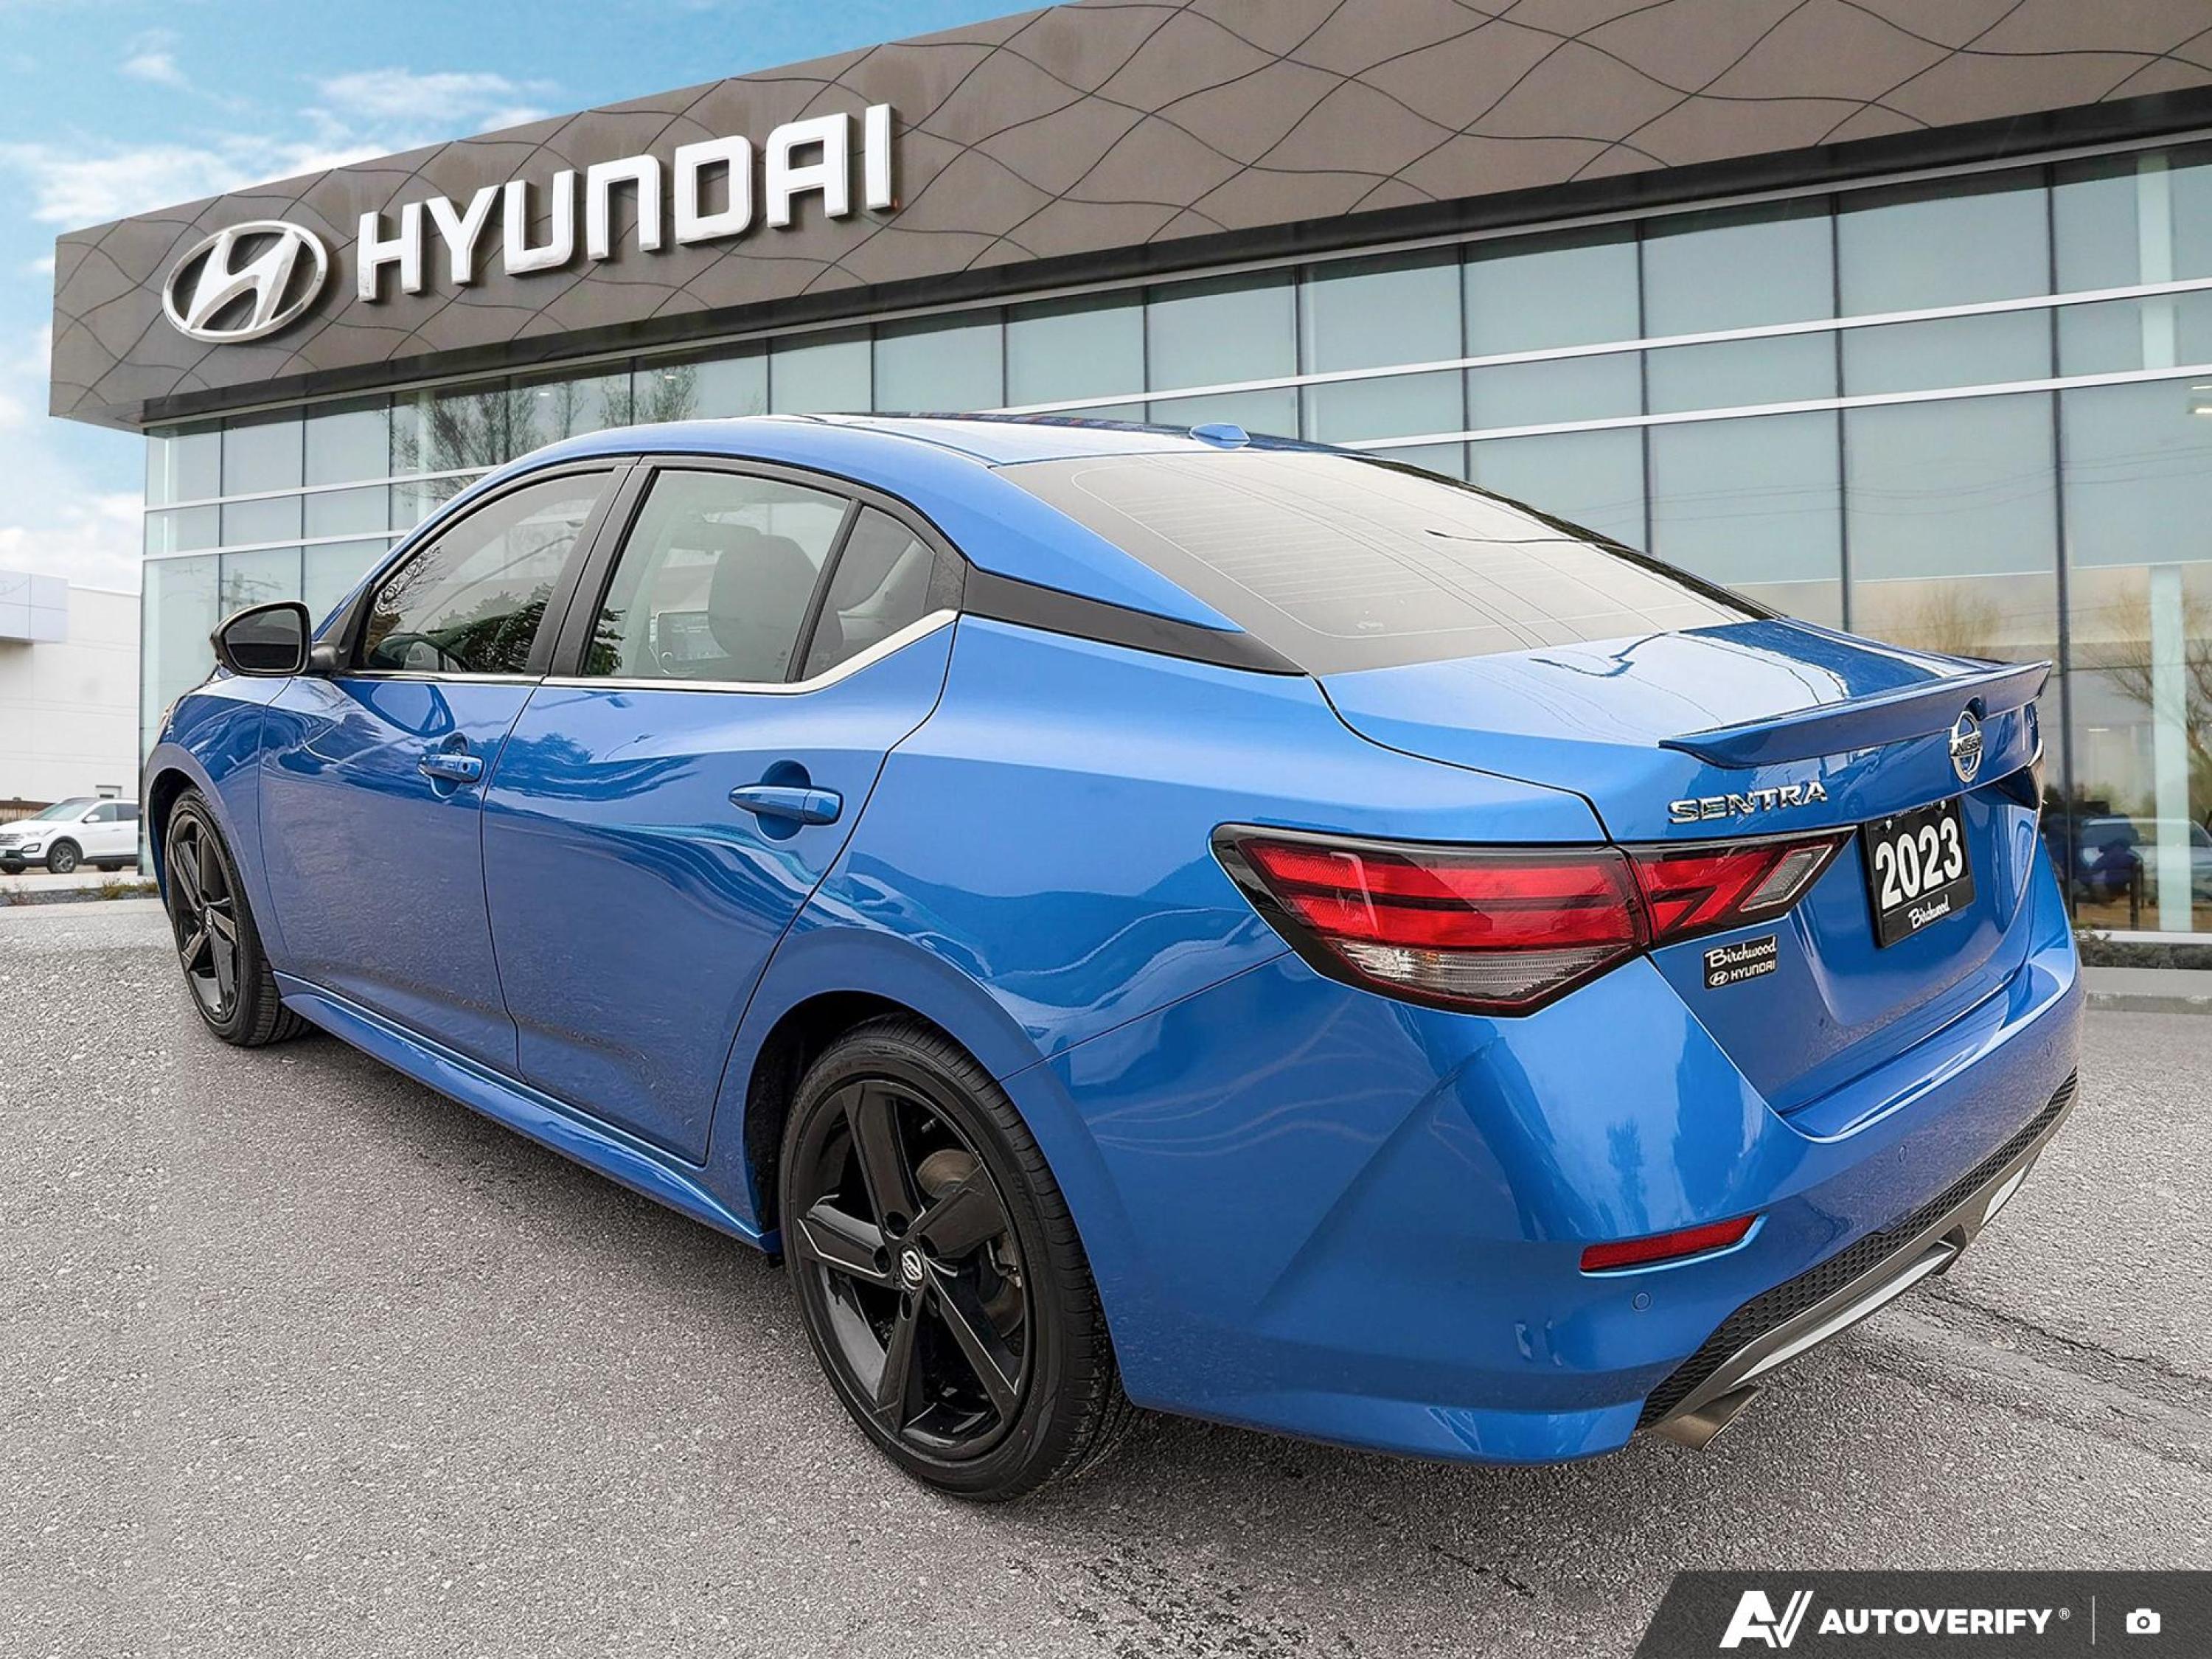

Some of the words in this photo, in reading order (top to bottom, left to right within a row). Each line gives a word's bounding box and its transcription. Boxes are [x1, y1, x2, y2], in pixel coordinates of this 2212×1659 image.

[358, 103, 892, 303] HYUNDAI
[1668, 781, 1828, 824] SENTRA
[1875, 817, 1963, 910] 2023
[1705, 936, 1776, 967] Birchwood
[1731, 959, 1776, 981] HYUNDAI
